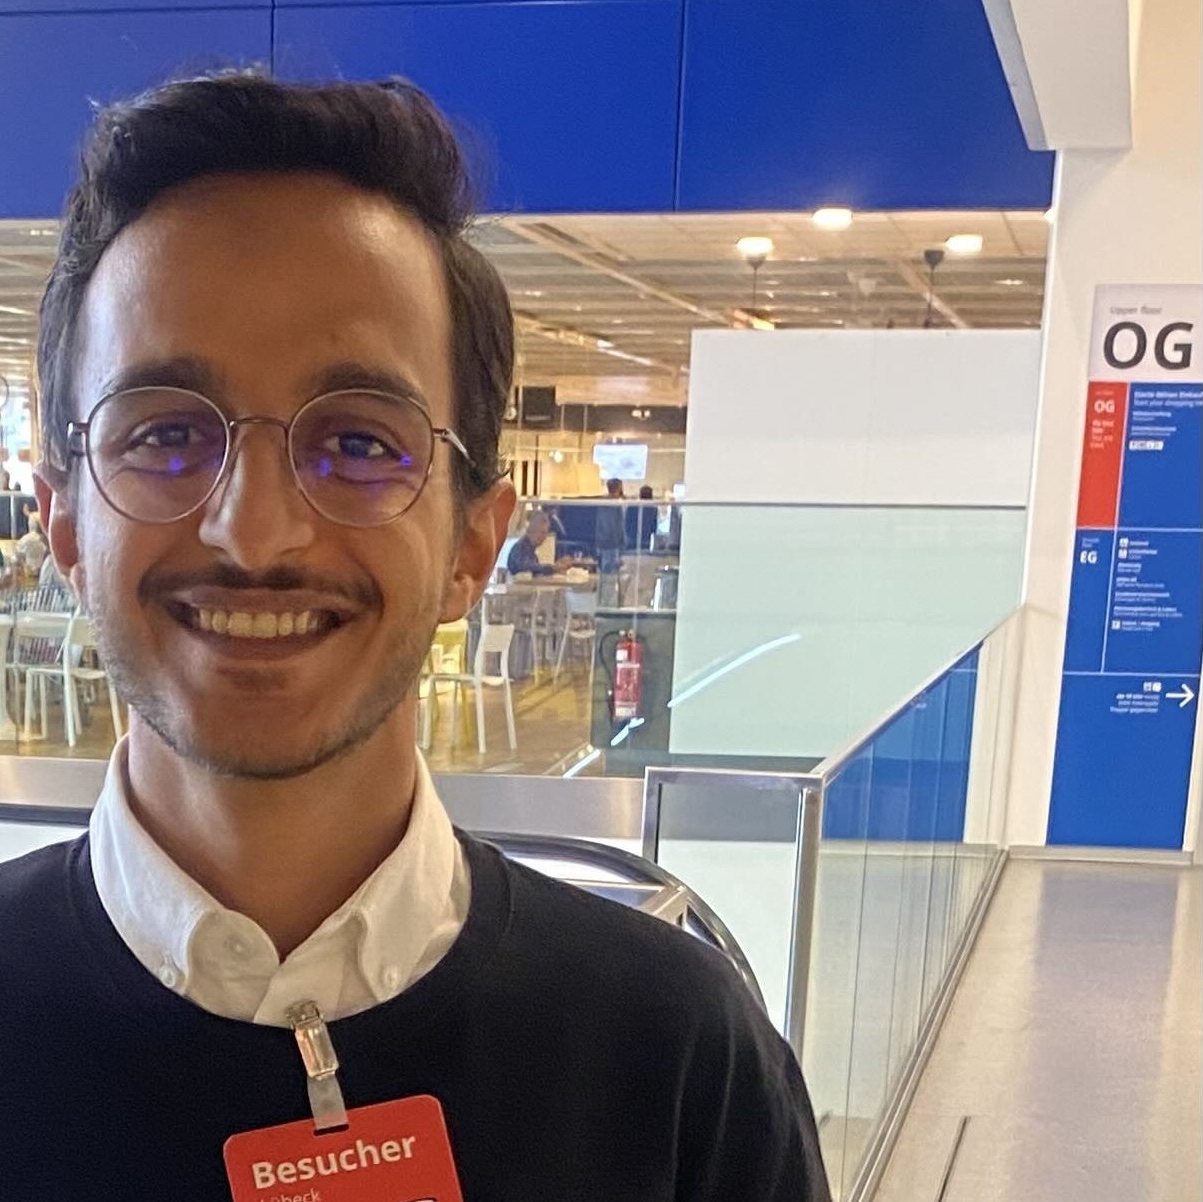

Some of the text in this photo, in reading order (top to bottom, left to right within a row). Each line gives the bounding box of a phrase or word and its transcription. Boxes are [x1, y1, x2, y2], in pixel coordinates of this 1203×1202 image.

[1102, 321, 1194, 370] OG
[1094, 399, 1115, 413] OG
[1080, 550, 1097, 564] EG
[251, 1134, 417, 1190] Besucher
